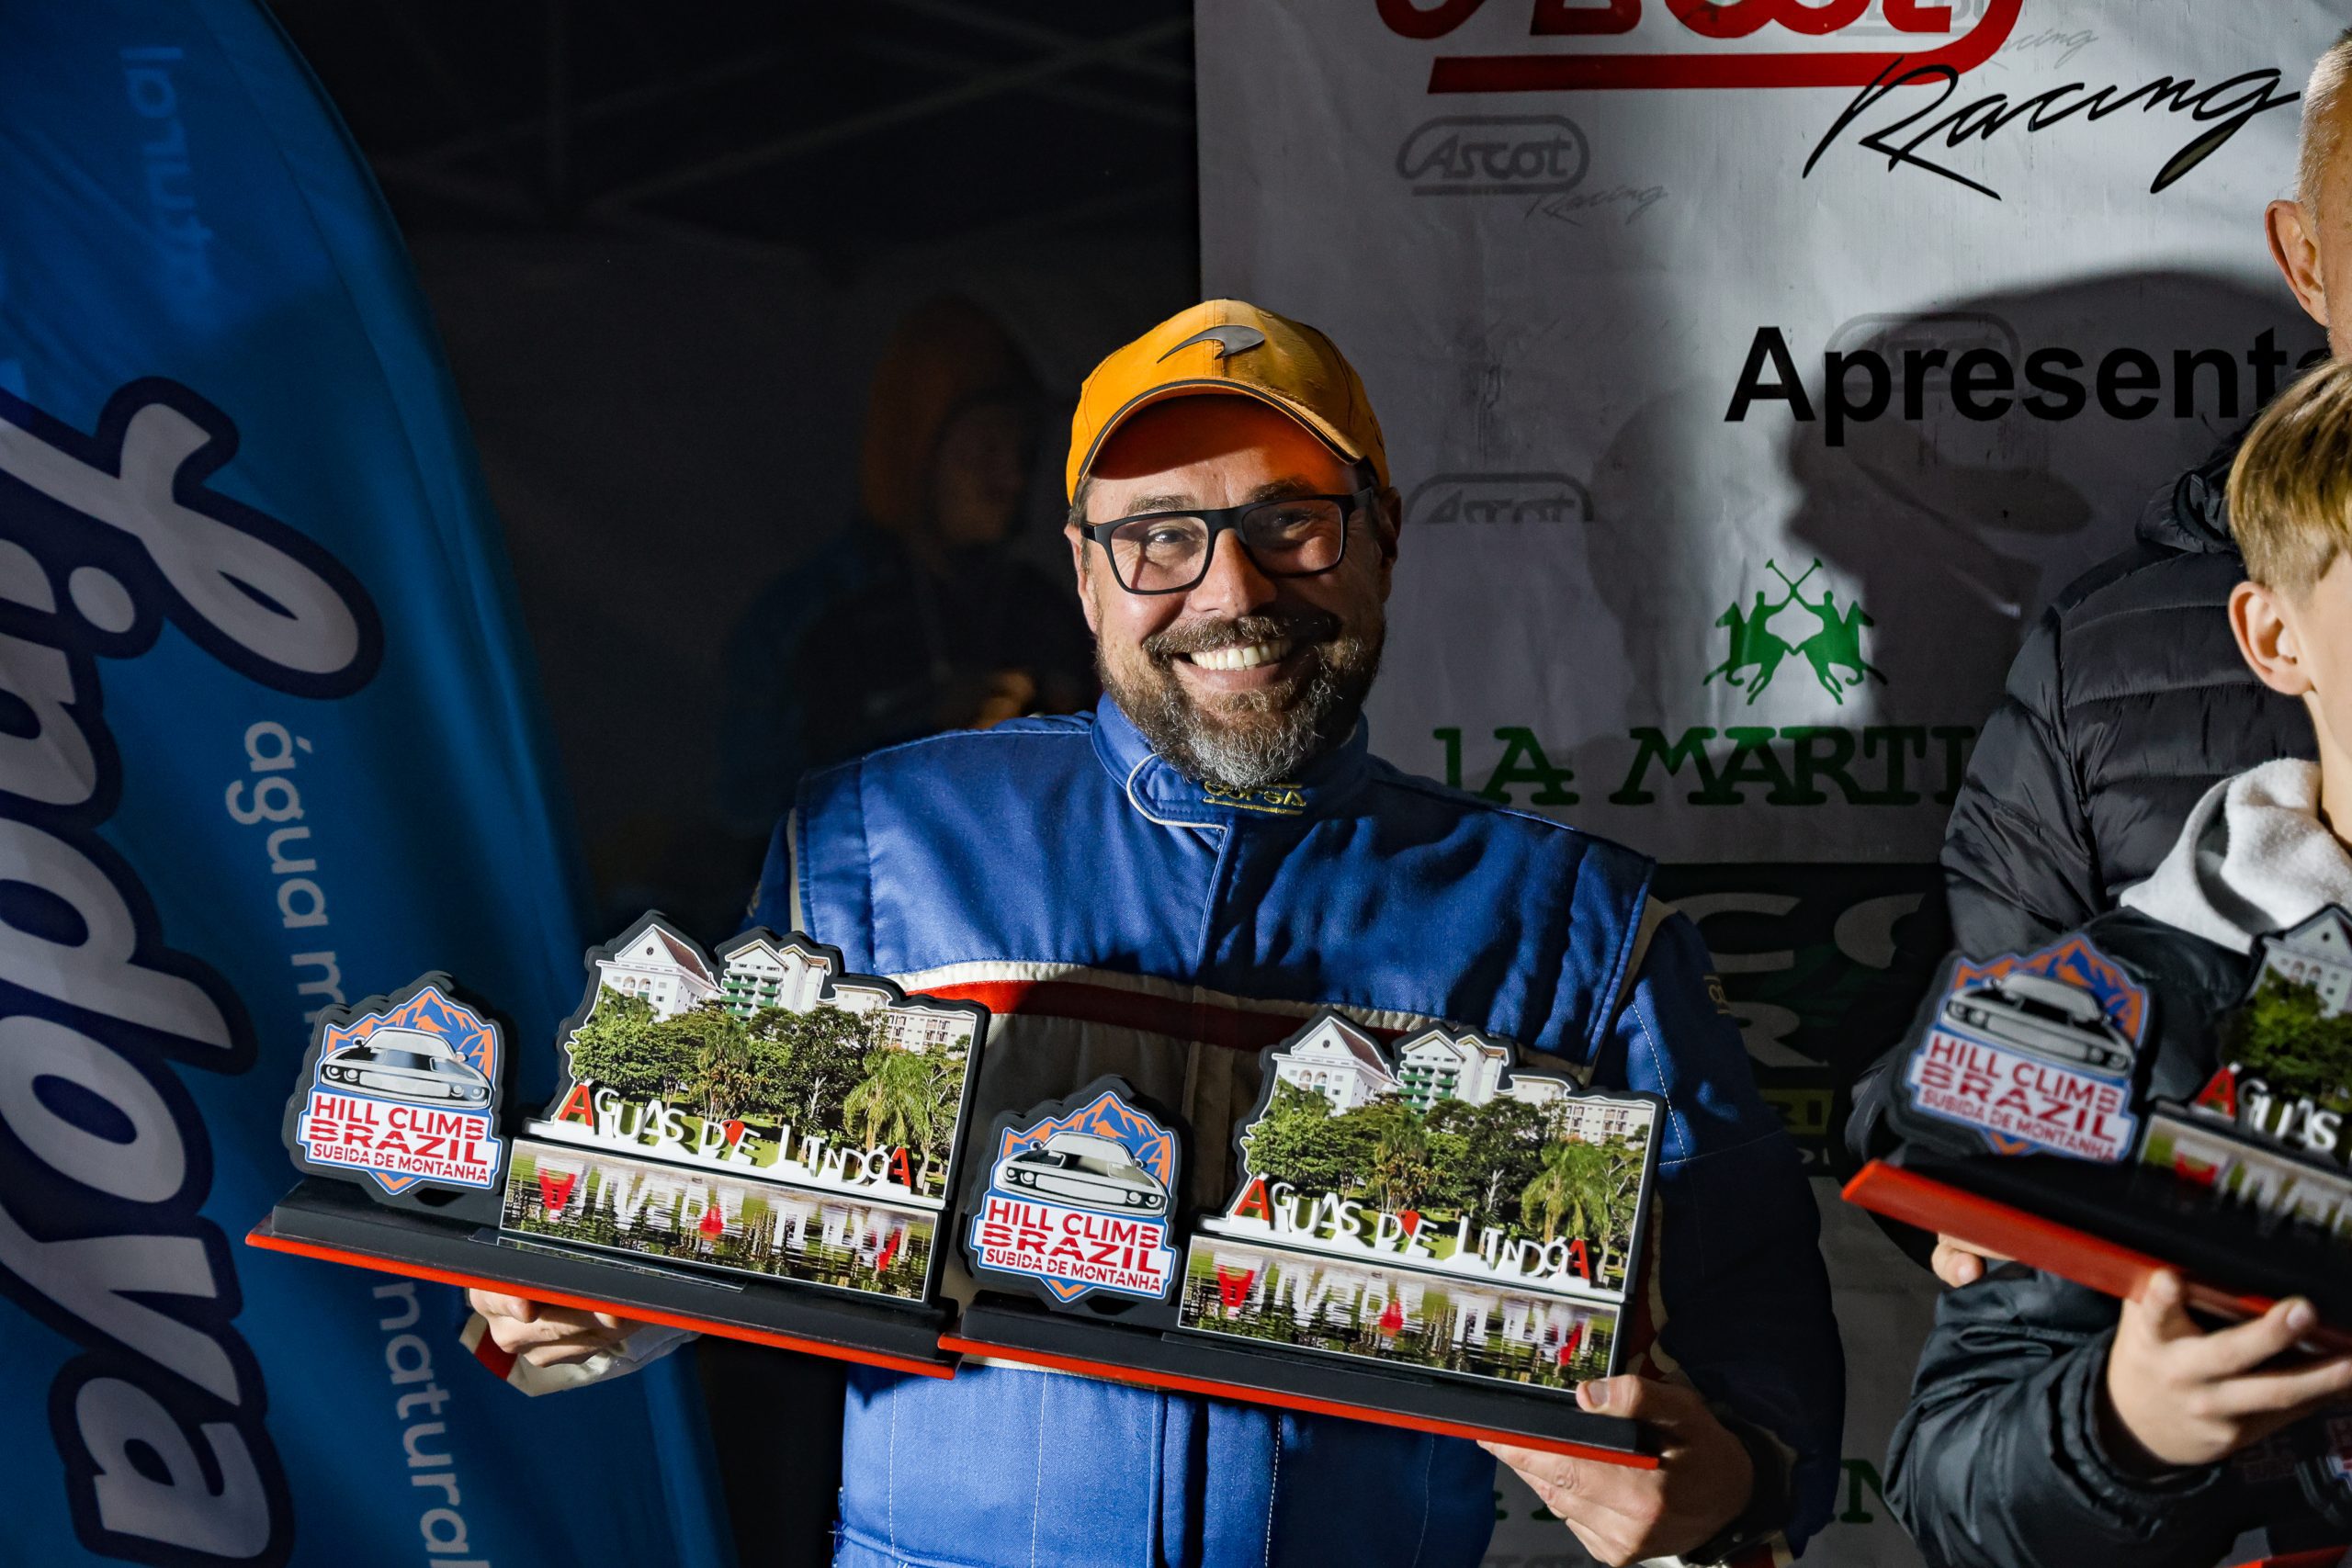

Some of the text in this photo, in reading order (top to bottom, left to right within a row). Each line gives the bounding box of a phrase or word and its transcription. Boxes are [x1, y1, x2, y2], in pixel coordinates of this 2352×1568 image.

[1803, 55, 2301, 201] Racing
[1724, 326, 2333, 446] Apresent
[1608, 726, 1977, 806] MARTI
[224, 720, 330, 930] água
[1919, 1058, 2117, 1144] BRAZIL
[1929, 1033, 2119, 1114] HILL CLIMB
[308, 1117, 489, 1166] BRAZIL
[312, 1094, 486, 1142] HILL CLIMB
[1922, 1088, 1985, 1122] SUBIDA
[1990, 1105, 2011, 1131] DE
[312, 1142, 489, 1183] SUBIDA DE MONTANHA
[981, 1222, 1161, 1275] BRAZIL
[987, 1199, 1161, 1249] HILL CLIMB
[985, 1247, 1161, 1293] SUBIDA DE MONTANHA
[371, 1280, 492, 1568] natural
